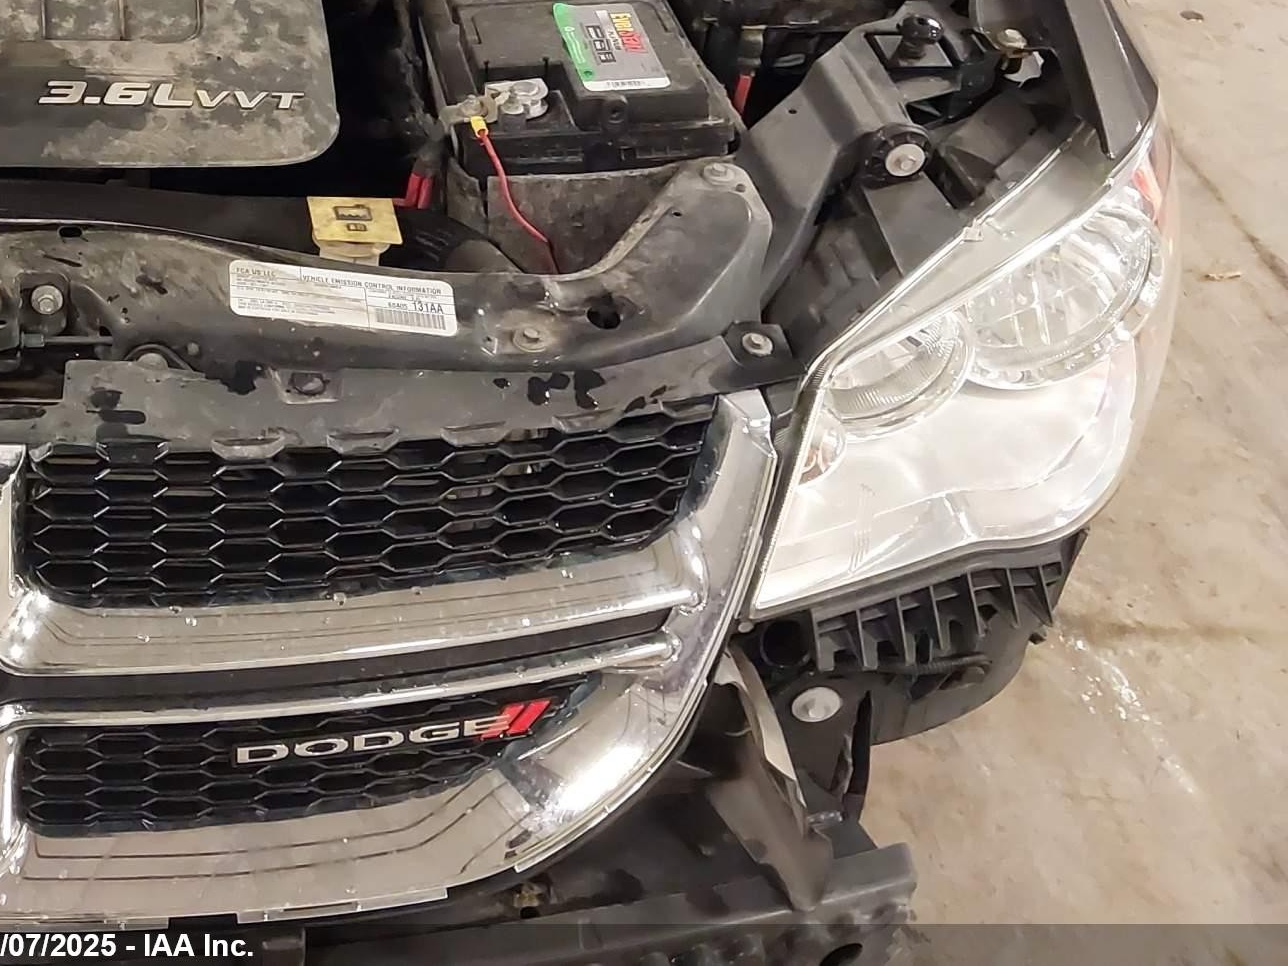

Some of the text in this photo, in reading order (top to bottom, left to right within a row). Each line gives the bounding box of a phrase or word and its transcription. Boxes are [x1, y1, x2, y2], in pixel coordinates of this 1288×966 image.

[38, 80, 305, 109] 3.6L VVT
[302, 274, 442, 295] VEHICLE EMISSION CONTROL INFORMATION
[236, 714, 510, 764] DODGE
